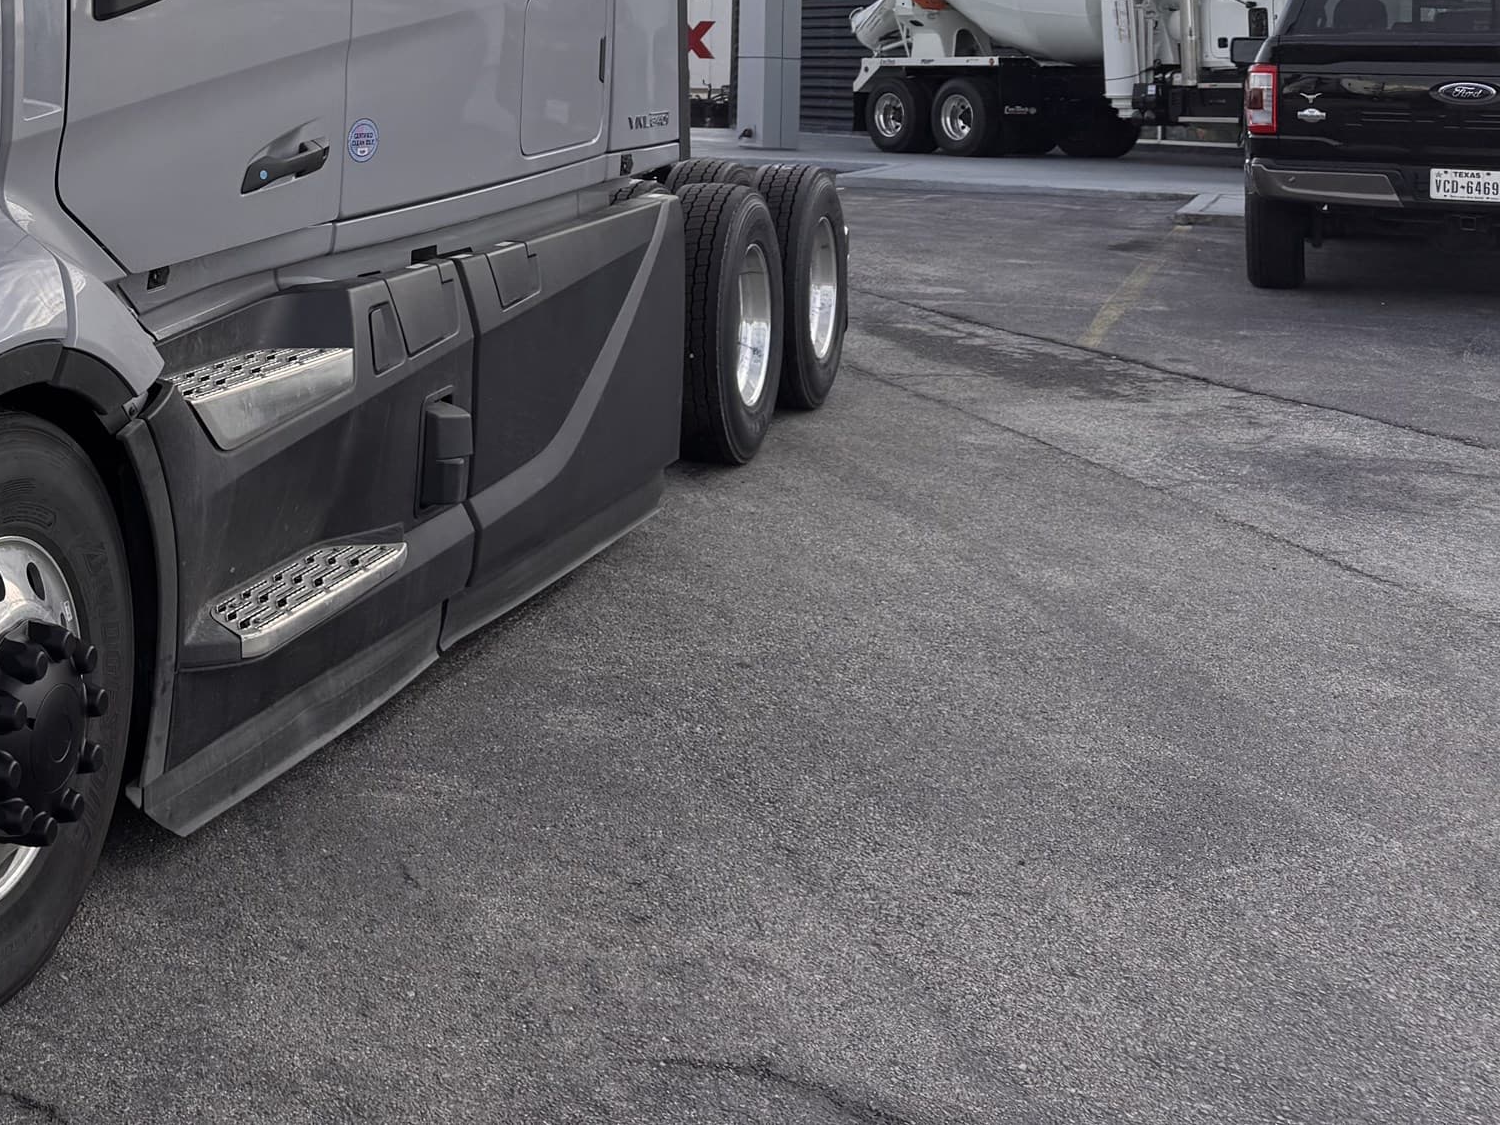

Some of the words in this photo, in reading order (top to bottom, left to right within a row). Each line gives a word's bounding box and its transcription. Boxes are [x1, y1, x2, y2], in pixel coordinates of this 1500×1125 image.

[1452, 86, 1483, 98] Ford
[1452, 171, 1482, 179] TEXAS
[1435, 178, 1499, 196] VCD-6469
